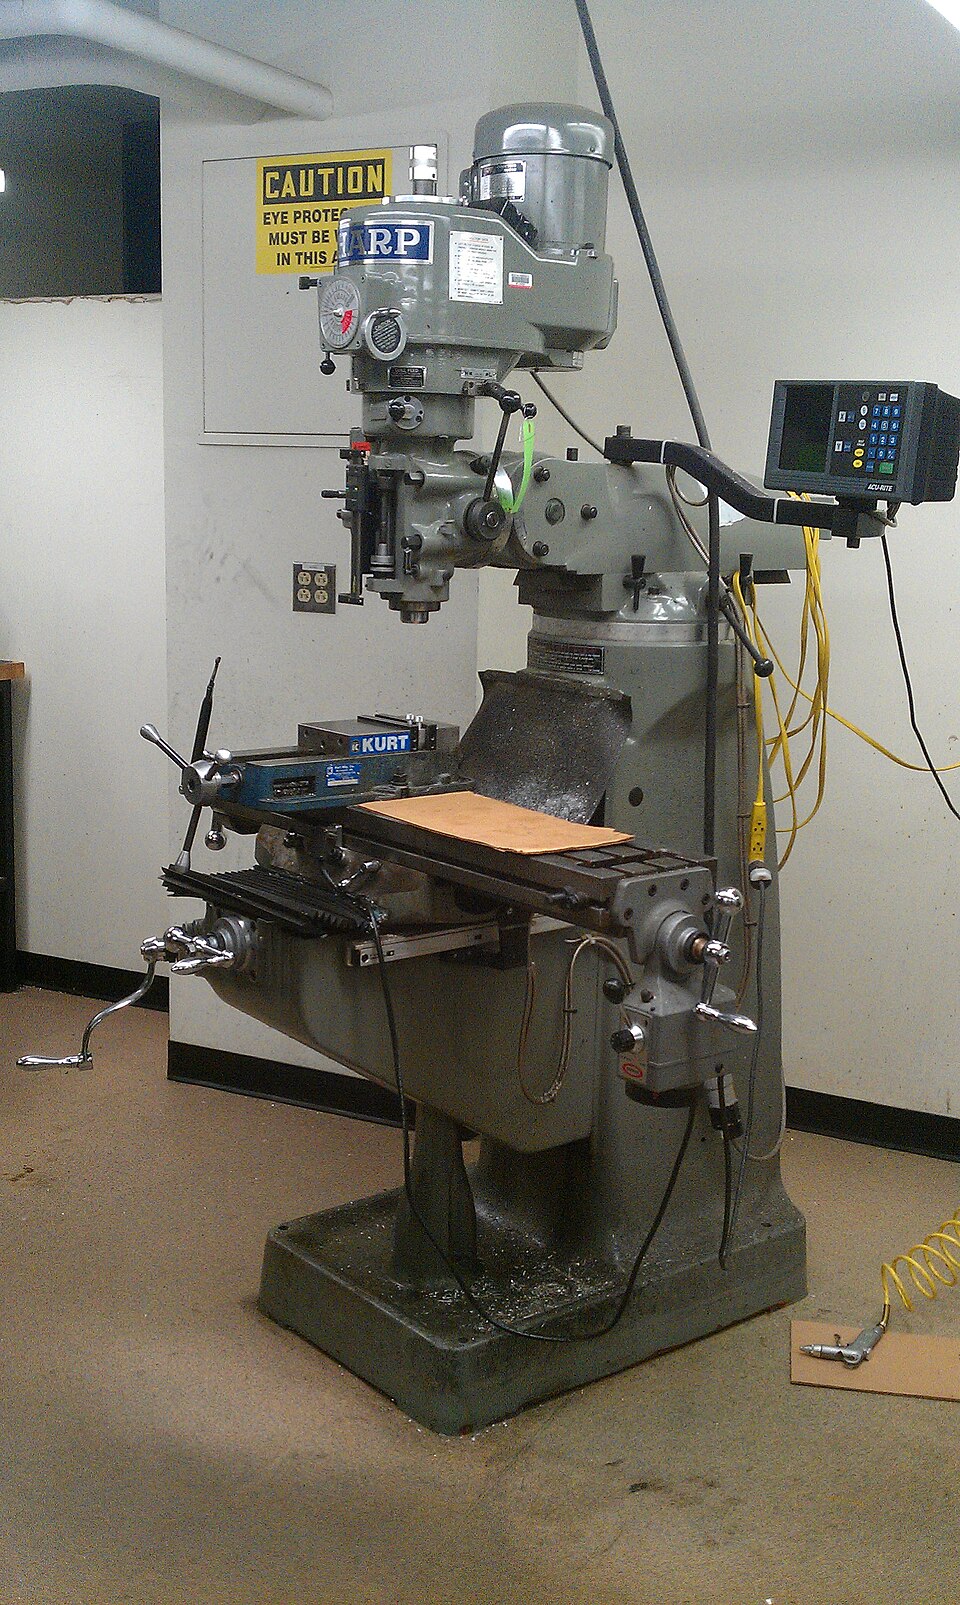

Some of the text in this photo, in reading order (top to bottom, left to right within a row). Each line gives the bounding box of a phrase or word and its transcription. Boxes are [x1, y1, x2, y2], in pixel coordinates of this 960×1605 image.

[265, 164, 383, 199] CAUTION
[263, 211, 288, 225] EYE
[269, 230, 307, 246] MUST
[312, 230, 329, 244] BE
[276, 252, 290, 266] IN
[295, 250, 327, 265] THIS
[868, 484, 893, 492] ACU-RITE
[362, 735, 409, 752] KURT
